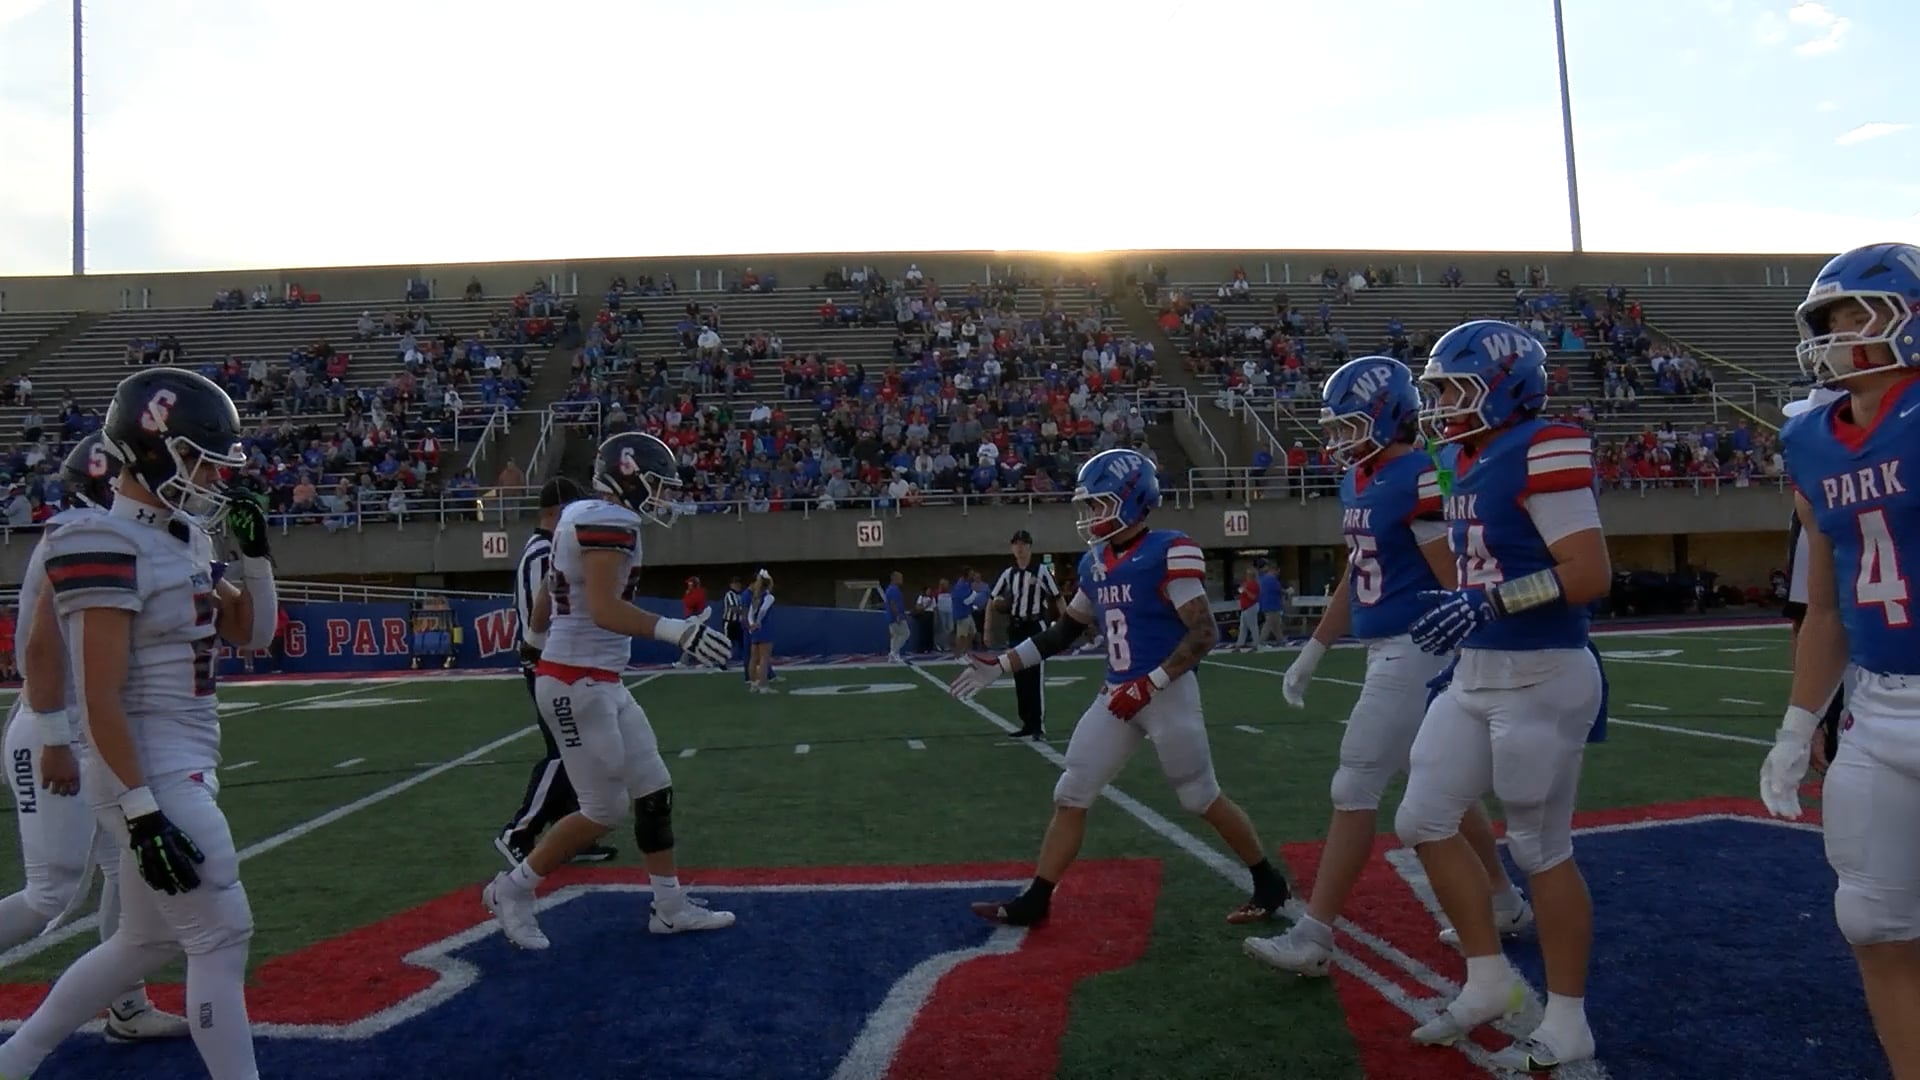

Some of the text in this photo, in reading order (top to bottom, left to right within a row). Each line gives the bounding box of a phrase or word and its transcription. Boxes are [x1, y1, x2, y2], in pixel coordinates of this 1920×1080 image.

[1482, 333, 1533, 361] WP
[1352, 366, 1392, 401] WP
[1108, 455, 1142, 479] WP
[1822, 460, 1906, 509] PARK
[859, 525, 882, 542] 50
[1226, 515, 1248, 532] 40
[1342, 508, 1372, 529] PARK
[484, 536, 507, 554] 40
[1857, 508, 1909, 625] 4
[1097, 584, 1132, 604] PARK
[326, 617, 410, 656] PAR
[1105, 608, 1132, 671] 8
[552, 696, 583, 748] SOUTH
[13, 748, 37, 814] SOUTH
